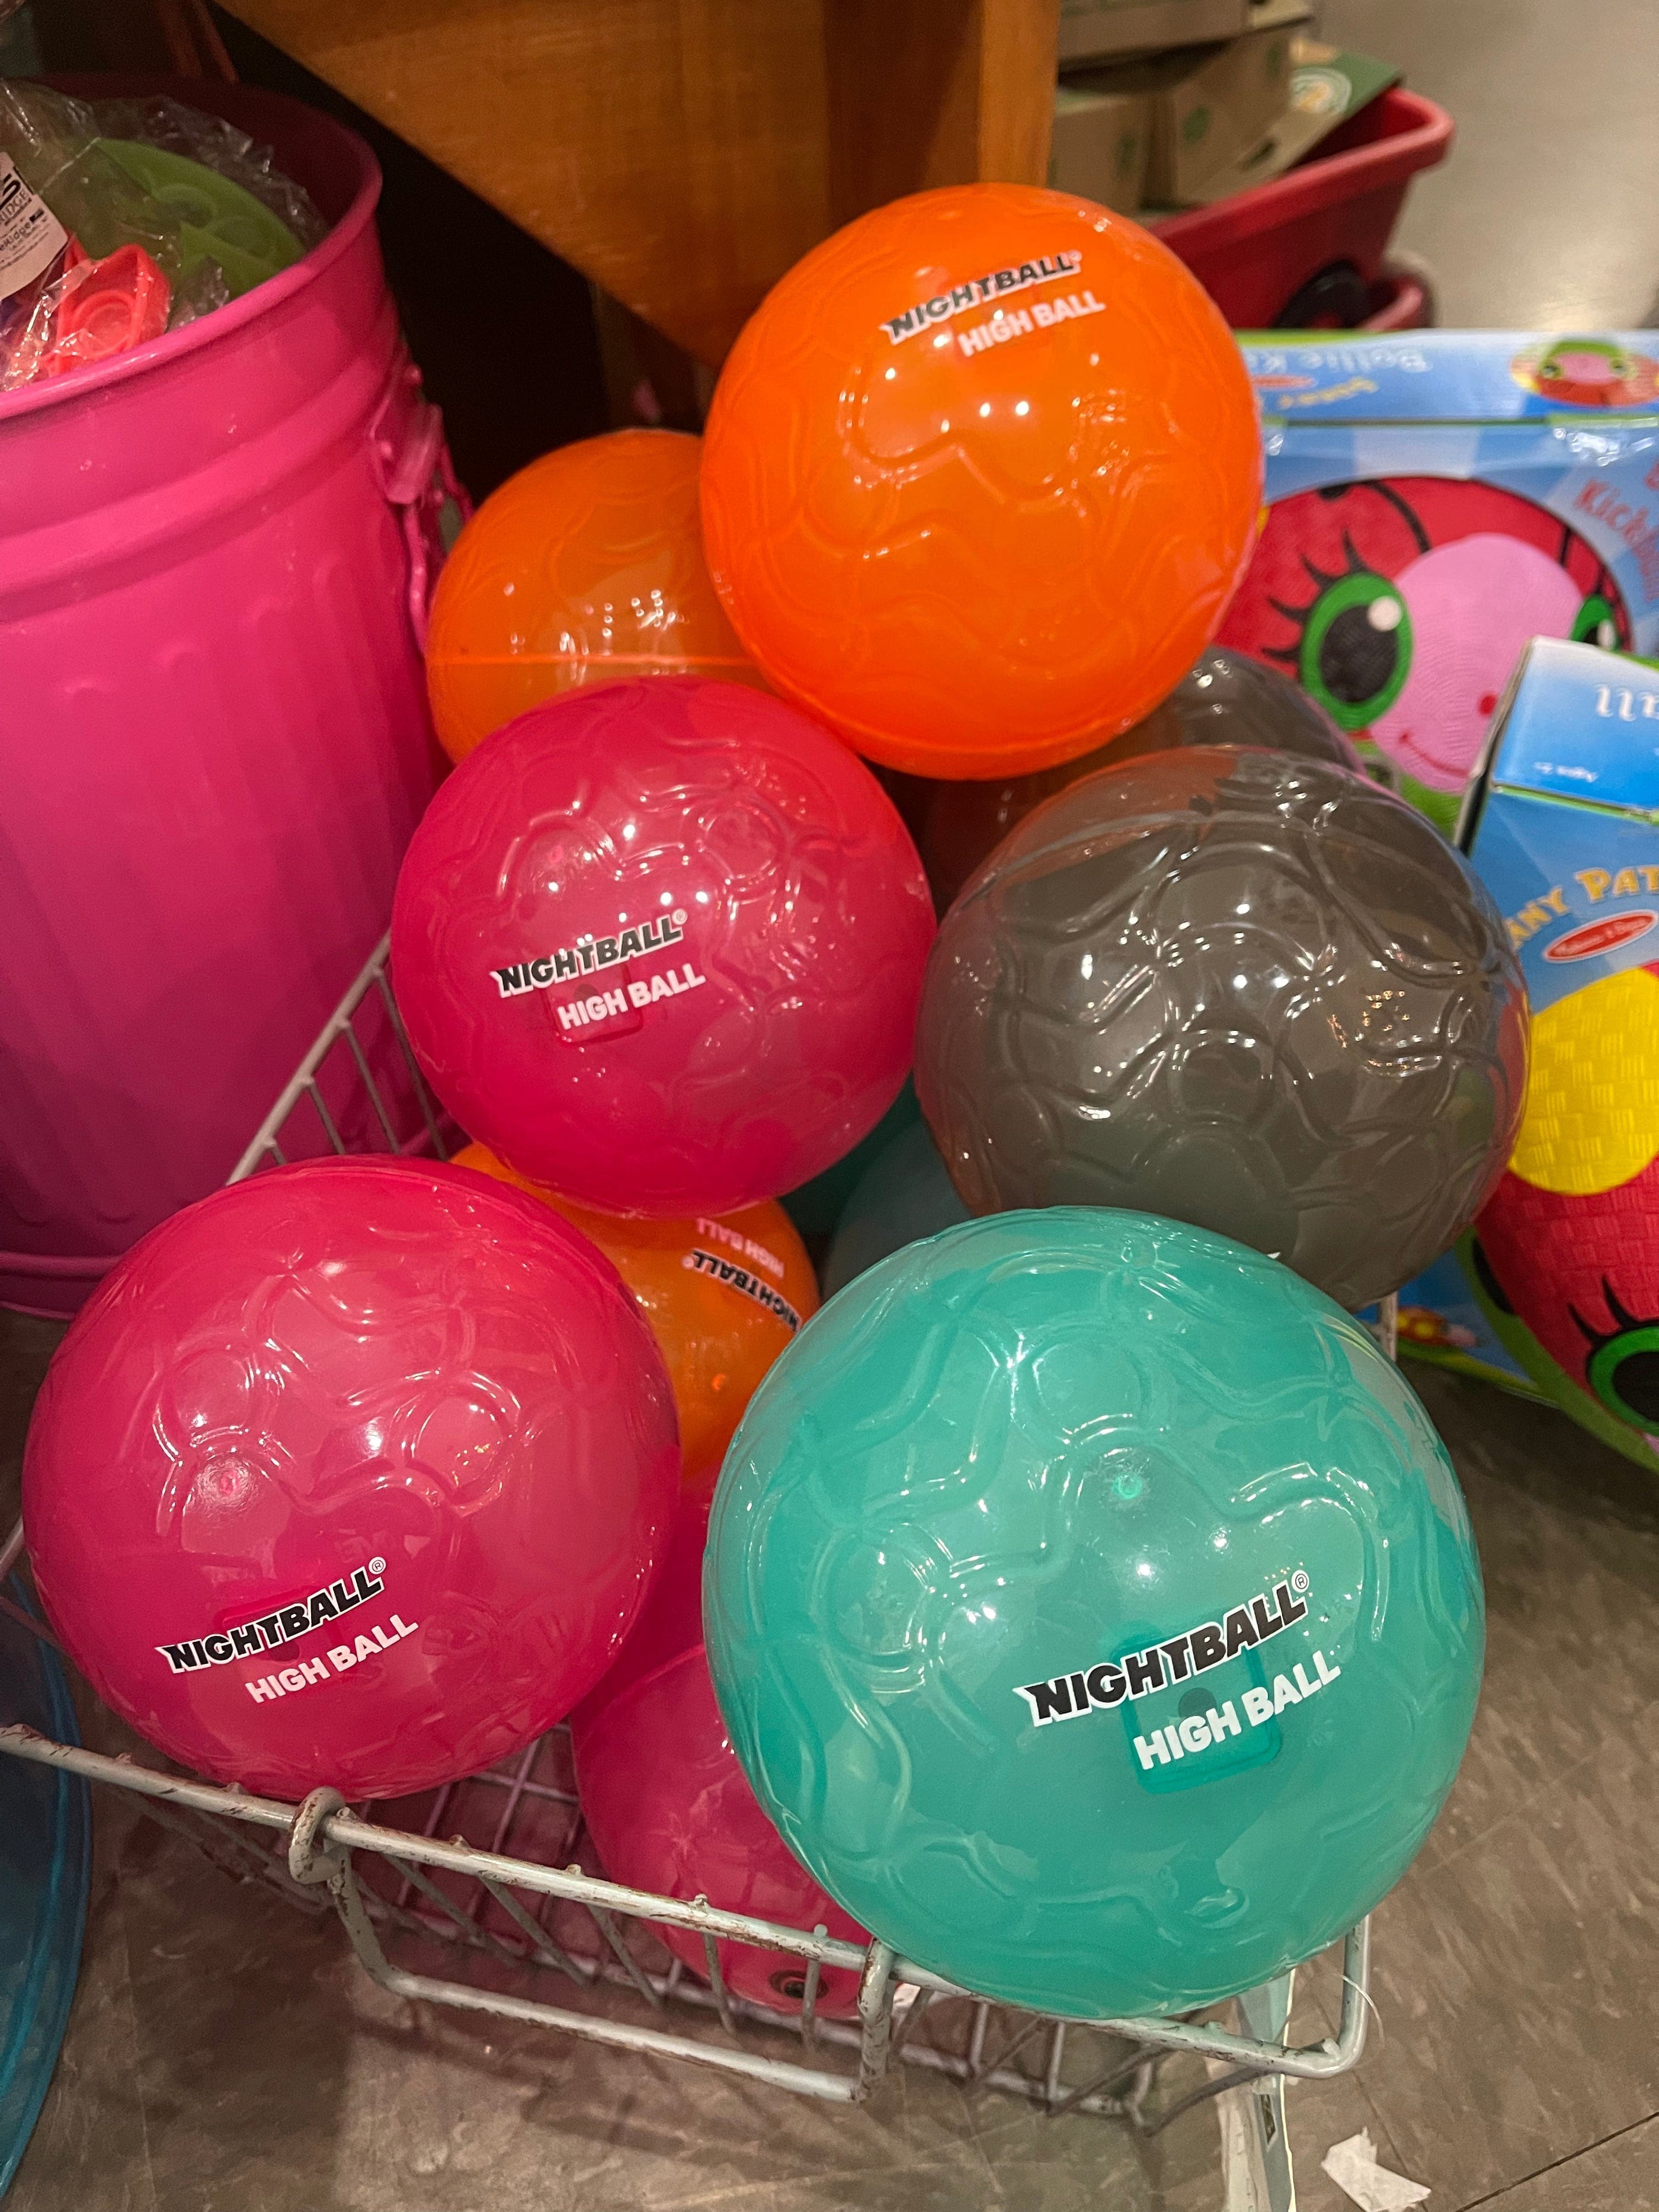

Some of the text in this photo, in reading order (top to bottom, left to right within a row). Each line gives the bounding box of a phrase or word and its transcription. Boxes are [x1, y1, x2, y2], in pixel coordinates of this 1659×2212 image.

[879, 250, 1082, 345] NIGHTBALL
[957, 290, 1107, 357] HIGH BALL
[489, 909, 687, 998] NIGHTBALL
[556, 963, 706, 1030] HIGH BALL
[696, 1217, 784, 1280] HIGH BALL
[154, 1557, 386, 1674] NIGHTBALL
[245, 1614, 419, 1704] HIGH BALL
[1013, 1570, 1309, 1727] NIGHTBALL
[1133, 1650, 1341, 1771] HIGH BALL
